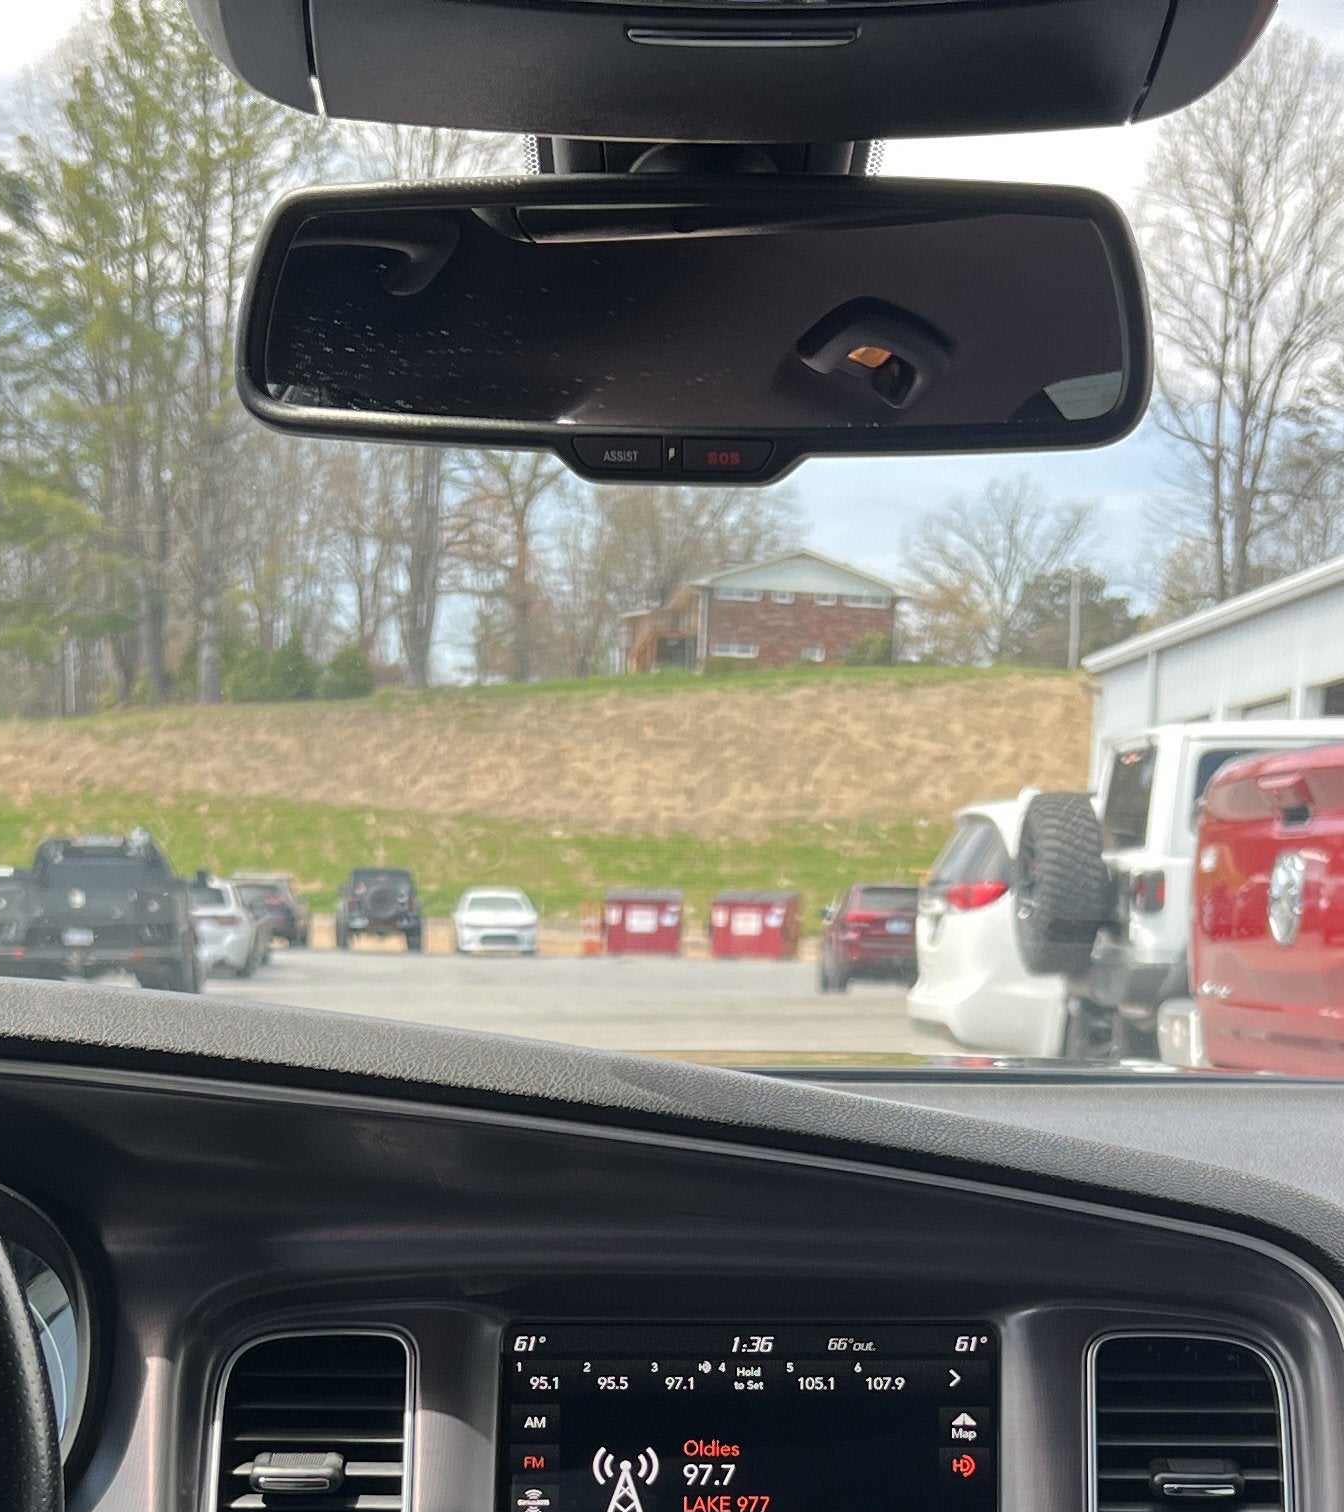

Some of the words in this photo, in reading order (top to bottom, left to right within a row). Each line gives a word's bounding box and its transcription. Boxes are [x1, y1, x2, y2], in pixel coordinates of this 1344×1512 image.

[603, 450, 639, 462] ASSIST
[707, 451, 741, 466] SOS
[731, 1335, 775, 1353] 1:36
[582, 1361, 592, 1373] 2
[650, 1361, 659, 1373] 3
[718, 1361, 727, 1373] 4
[736, 1366, 762, 1377] Hold
[786, 1361, 795, 1373] 5
[854, 1361, 862, 1373] 6
[529, 1376, 560, 1390] 95.1
[597, 1376, 629, 1390] 95.5
[664, 1376, 695, 1390] 97.1
[733, 1380, 745, 1391] to
[746, 1380, 764, 1391] Set
[797, 1376, 836, 1391] 105.1
[865, 1376, 906, 1391] 107.9
[523, 1416, 547, 1429] AM
[951, 1427, 977, 1441] Map
[682, 1439, 741, 1458] Oldies
[523, 1455, 545, 1469] FM
[682, 1463, 737, 1486] 97.7
